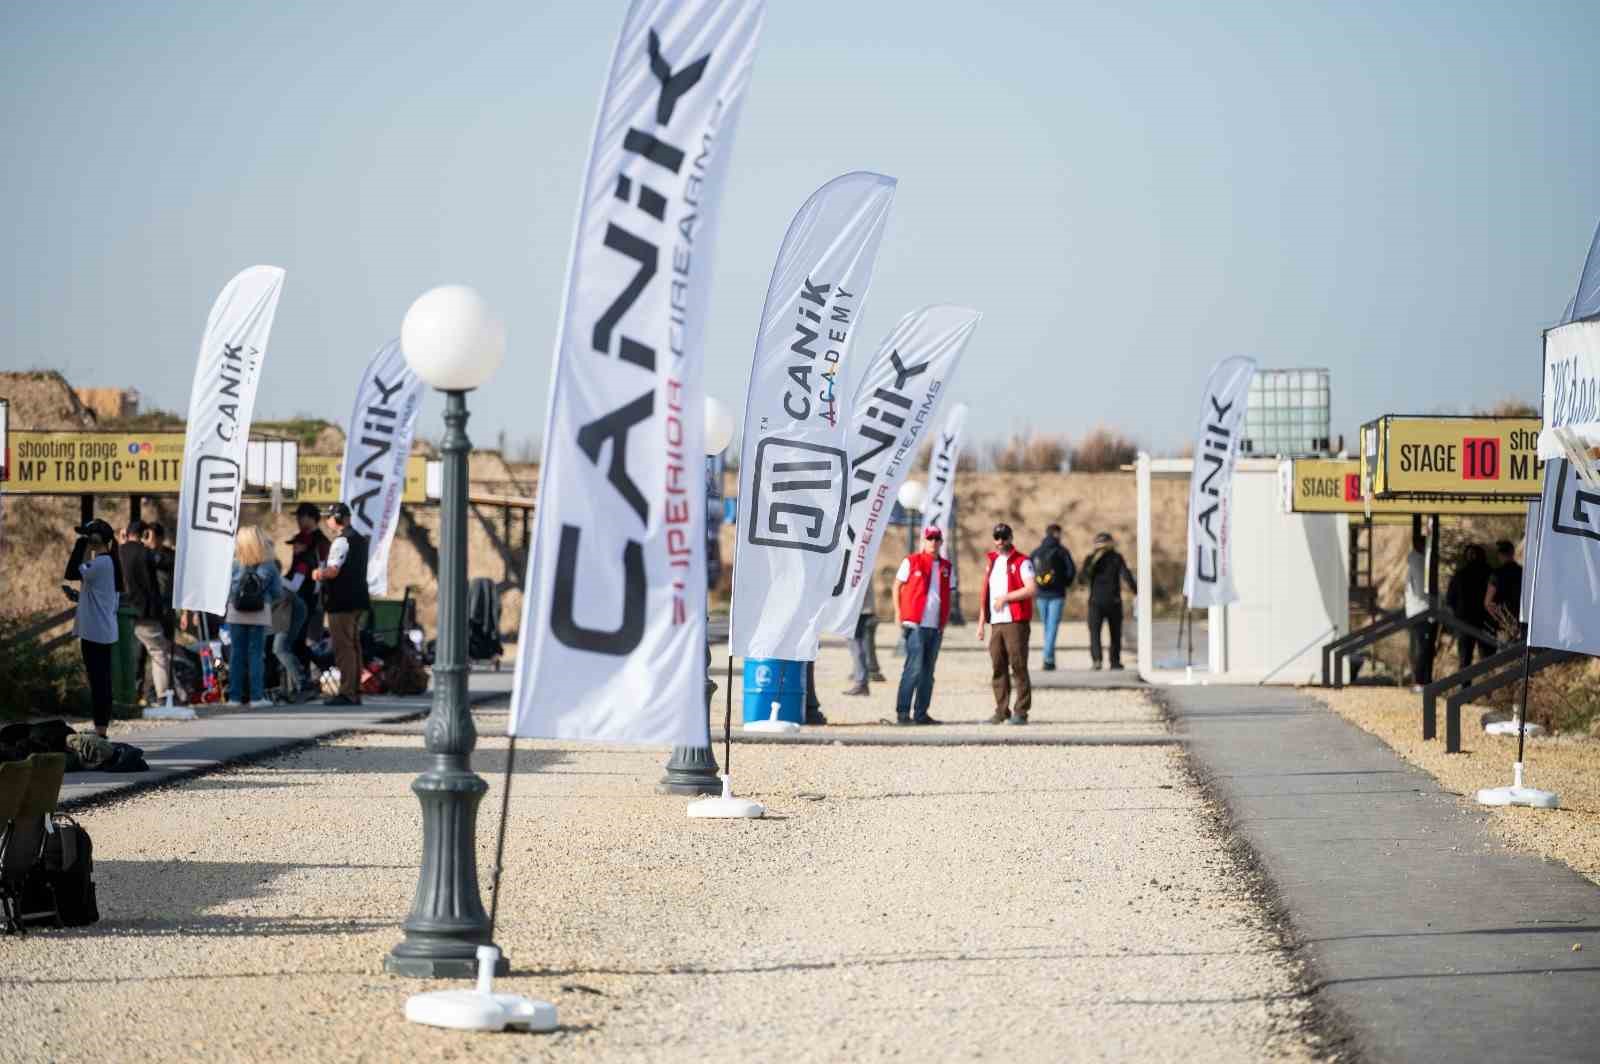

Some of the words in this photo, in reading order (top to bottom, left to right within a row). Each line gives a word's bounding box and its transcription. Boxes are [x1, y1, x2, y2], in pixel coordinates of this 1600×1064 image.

[818, 287, 853, 428] ACADEMY
[18, 440, 75, 459] shooting
[79, 443, 118, 460] range
[1400, 444, 1457, 473] STAGE
[1465, 440, 1498, 478] 10
[18, 461, 47, 481] MP
[850, 484, 889, 589] SUPERIOR
[885, 379, 942, 478] FIREARMS
[1302, 477, 1340, 498] STAGE
